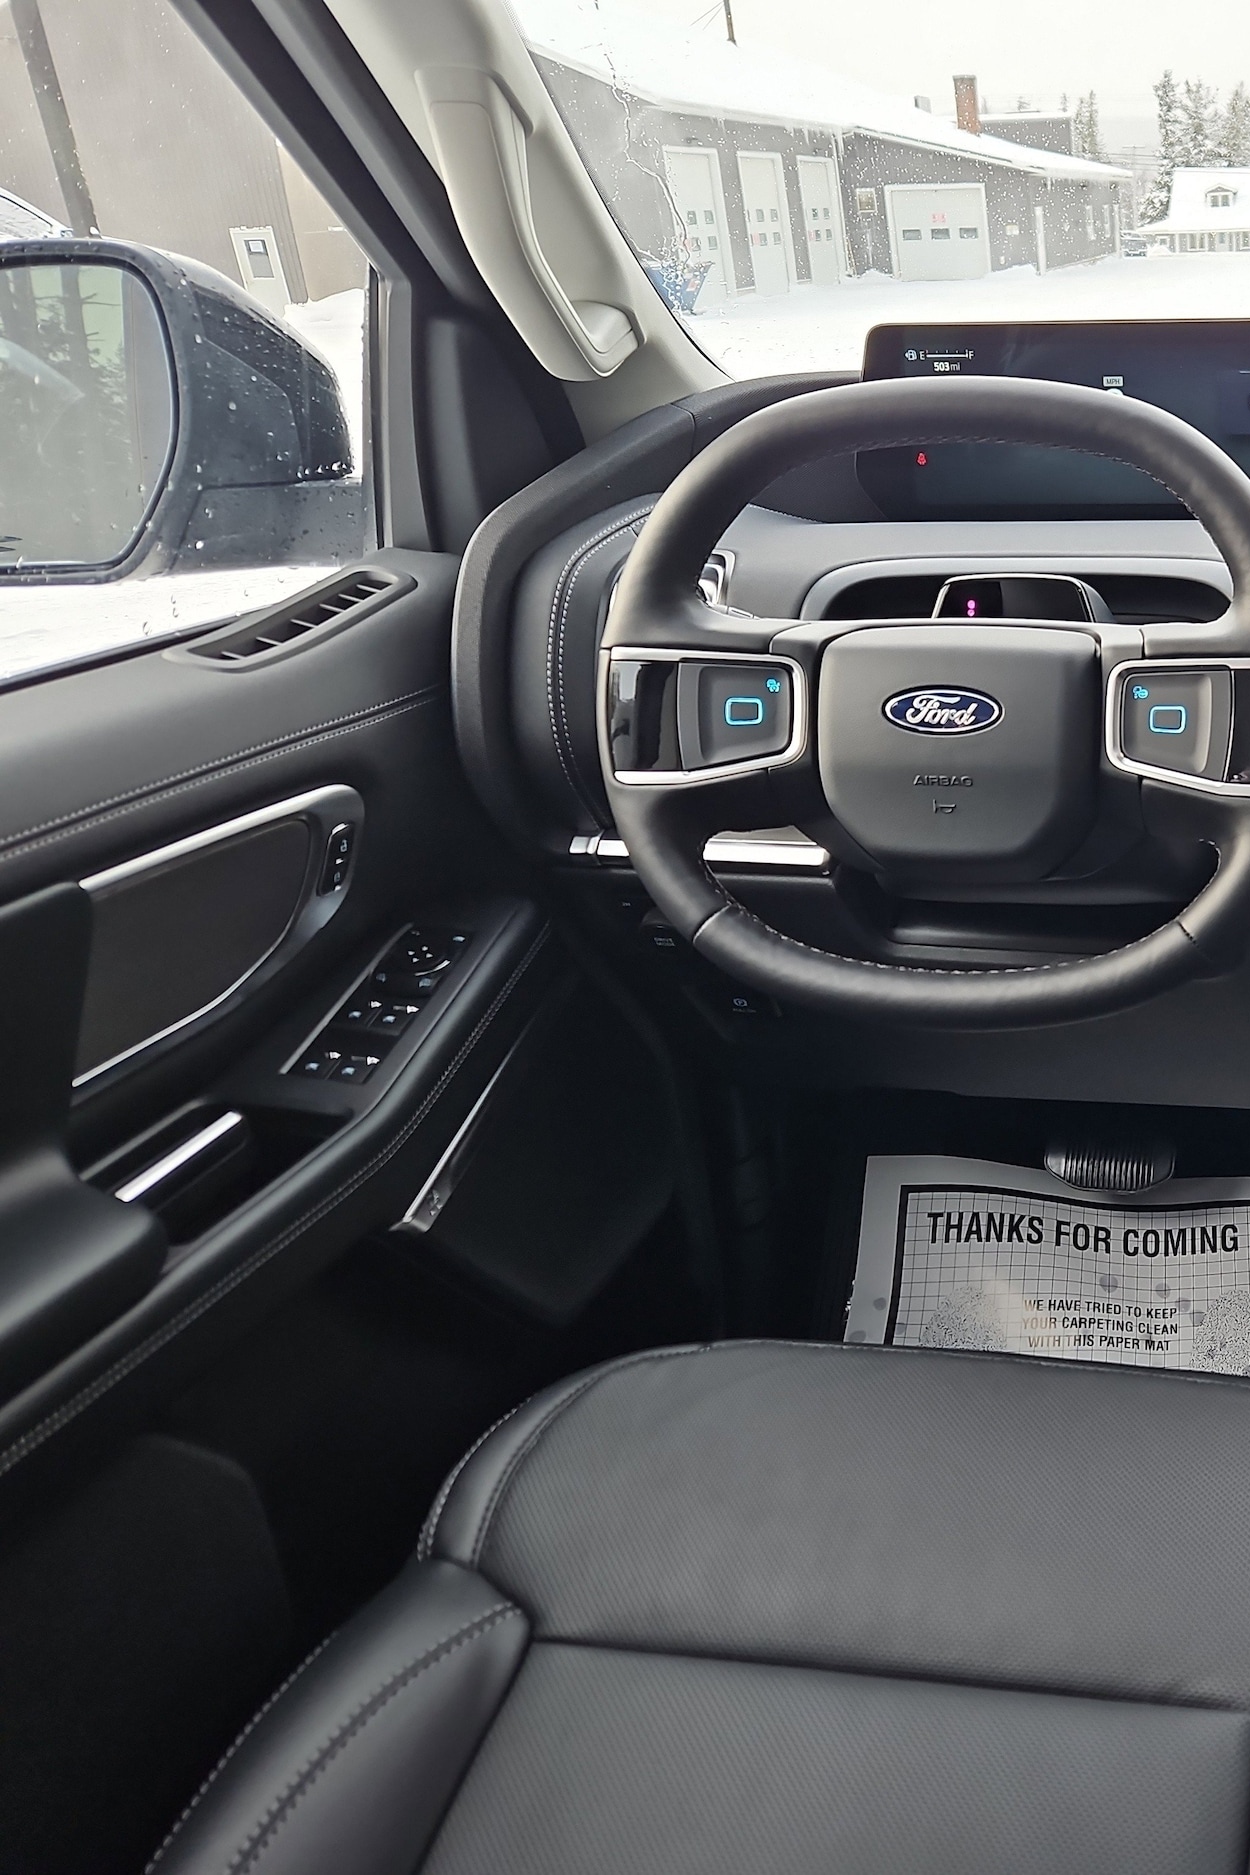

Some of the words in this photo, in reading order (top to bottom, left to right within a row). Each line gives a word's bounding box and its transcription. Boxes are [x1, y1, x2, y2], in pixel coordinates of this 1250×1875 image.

[919, 350, 925, 360] E
[933, 361, 950, 371] 503
[950, 362, 961, 371] mi
[1106, 377, 1121, 386] MPH
[905, 695, 978, 726] Ford
[913, 774, 973, 787] AIRBAG
[927, 1211, 1045, 1246] THANKS
[1055, 1220, 1112, 1255] FOR
[1123, 1222, 1239, 1259] COMING
[1023, 1299, 1044, 1311] WE
[1048, 1300, 1082, 1313] HAVE
[1085, 1301, 1123, 1316] TRIED
[1126, 1304, 1143, 1317] TO
[1146, 1306, 1178, 1319] KEEP
[1022, 1316, 1057, 1330] YOUR
[1061, 1317, 1135, 1333] CARPETING
[1138, 1320, 1178, 1335] CLEAN
[1028, 1335, 1062, 1348] WITH
[1066, 1335, 1095, 1348] THIS
[1099, 1336, 1141, 1350] PAPER
[1144, 1338, 1172, 1352] MAT
